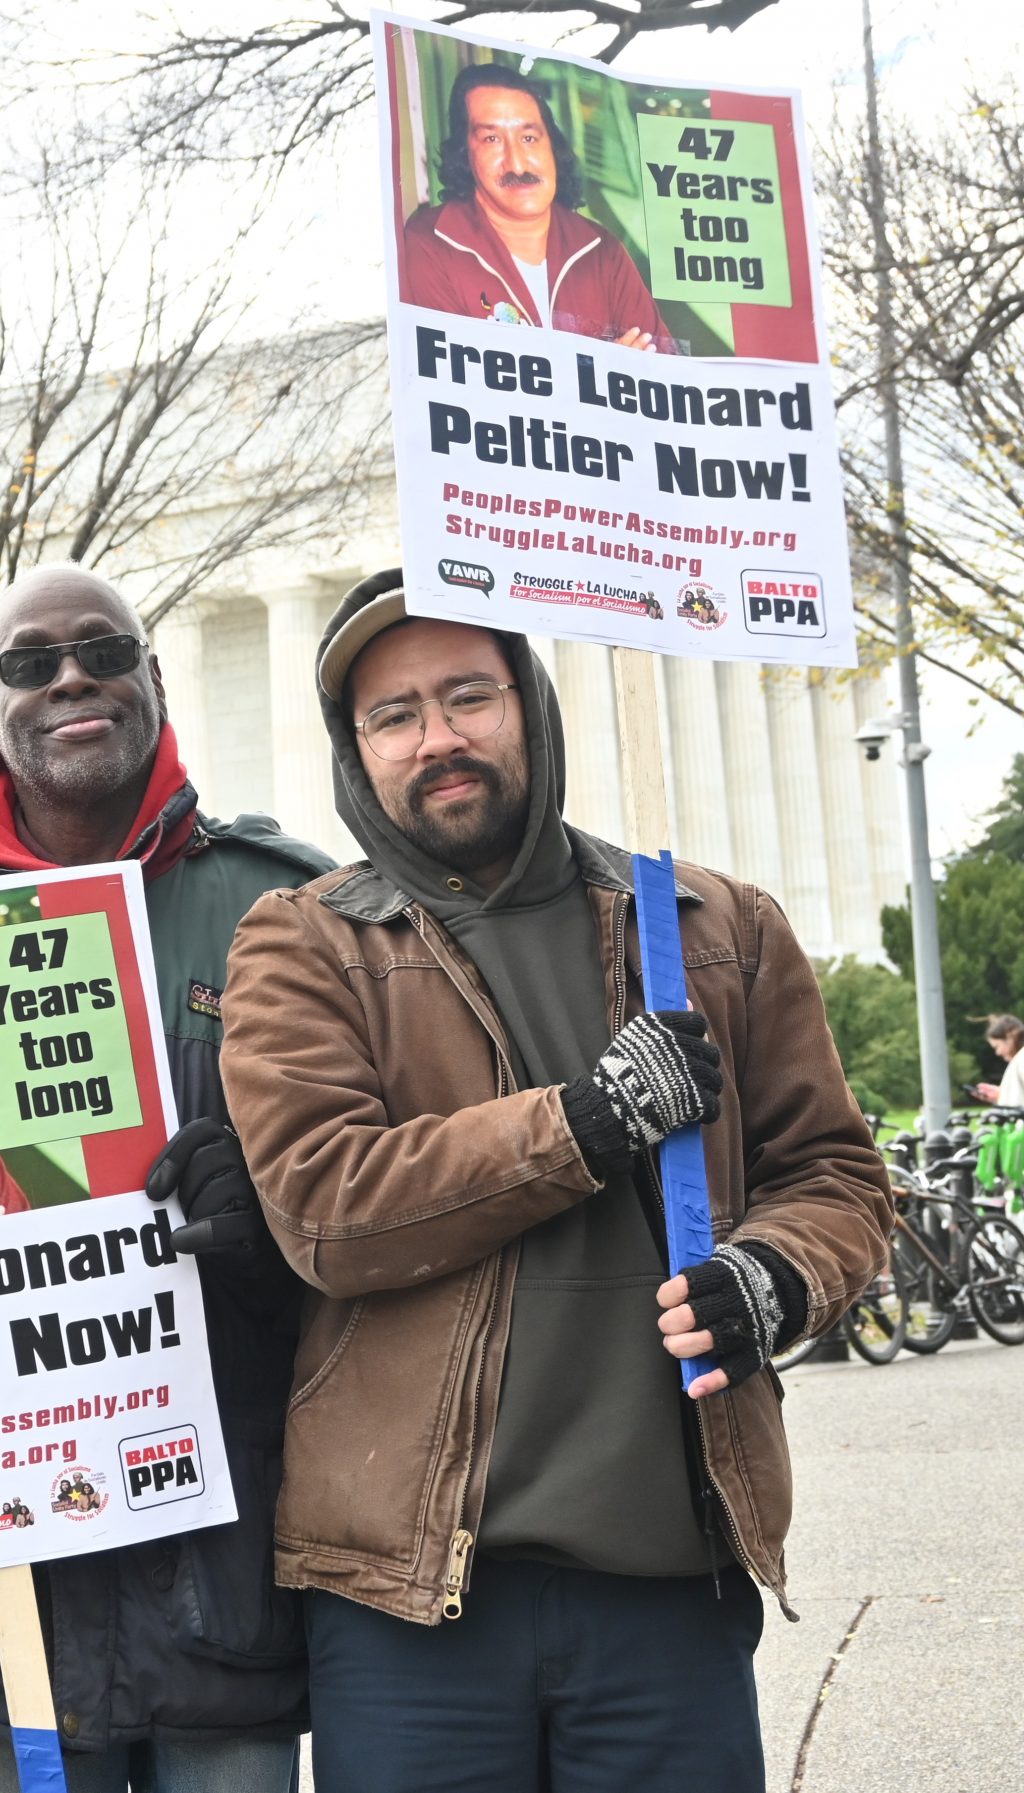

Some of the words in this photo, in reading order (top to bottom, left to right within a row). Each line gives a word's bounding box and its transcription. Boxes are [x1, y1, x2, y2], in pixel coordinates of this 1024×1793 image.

[679, 128, 734, 161] 47
[647, 163, 773, 203] Years
[681, 209, 748, 242] too
[675, 247, 763, 289] long
[417, 326, 552, 396] Free
[577, 352, 811, 430] Leonard
[429, 402, 633, 481] Peltier
[655, 443, 810, 501] Now!
[444, 483, 796, 552] PeoplesPowerAssembly.org
[447, 515, 702, 576] StruggleLaLucha.org
[441, 562, 491, 583] YAWR
[513, 571, 573, 591] STRUGGLE
[587, 581, 600, 594] LA
[604, 584, 638, 601] LUCHA
[748, 581, 818, 598] BALTO
[513, 586, 526, 597] for
[528, 588, 572, 603] Socialism
[576, 594, 591, 606] por
[592, 596, 601, 605] el
[602, 598, 646, 614] Socialismo
[750, 597, 818, 625] PPA
[9, 928, 68, 972] 47
[19, 1032, 93, 1070] too
[15, 1076, 113, 1120] long
[10, 1291, 180, 1376] Now!
[126, 1438, 194, 1466] BALTO
[129, 1452, 197, 1497] PPA
